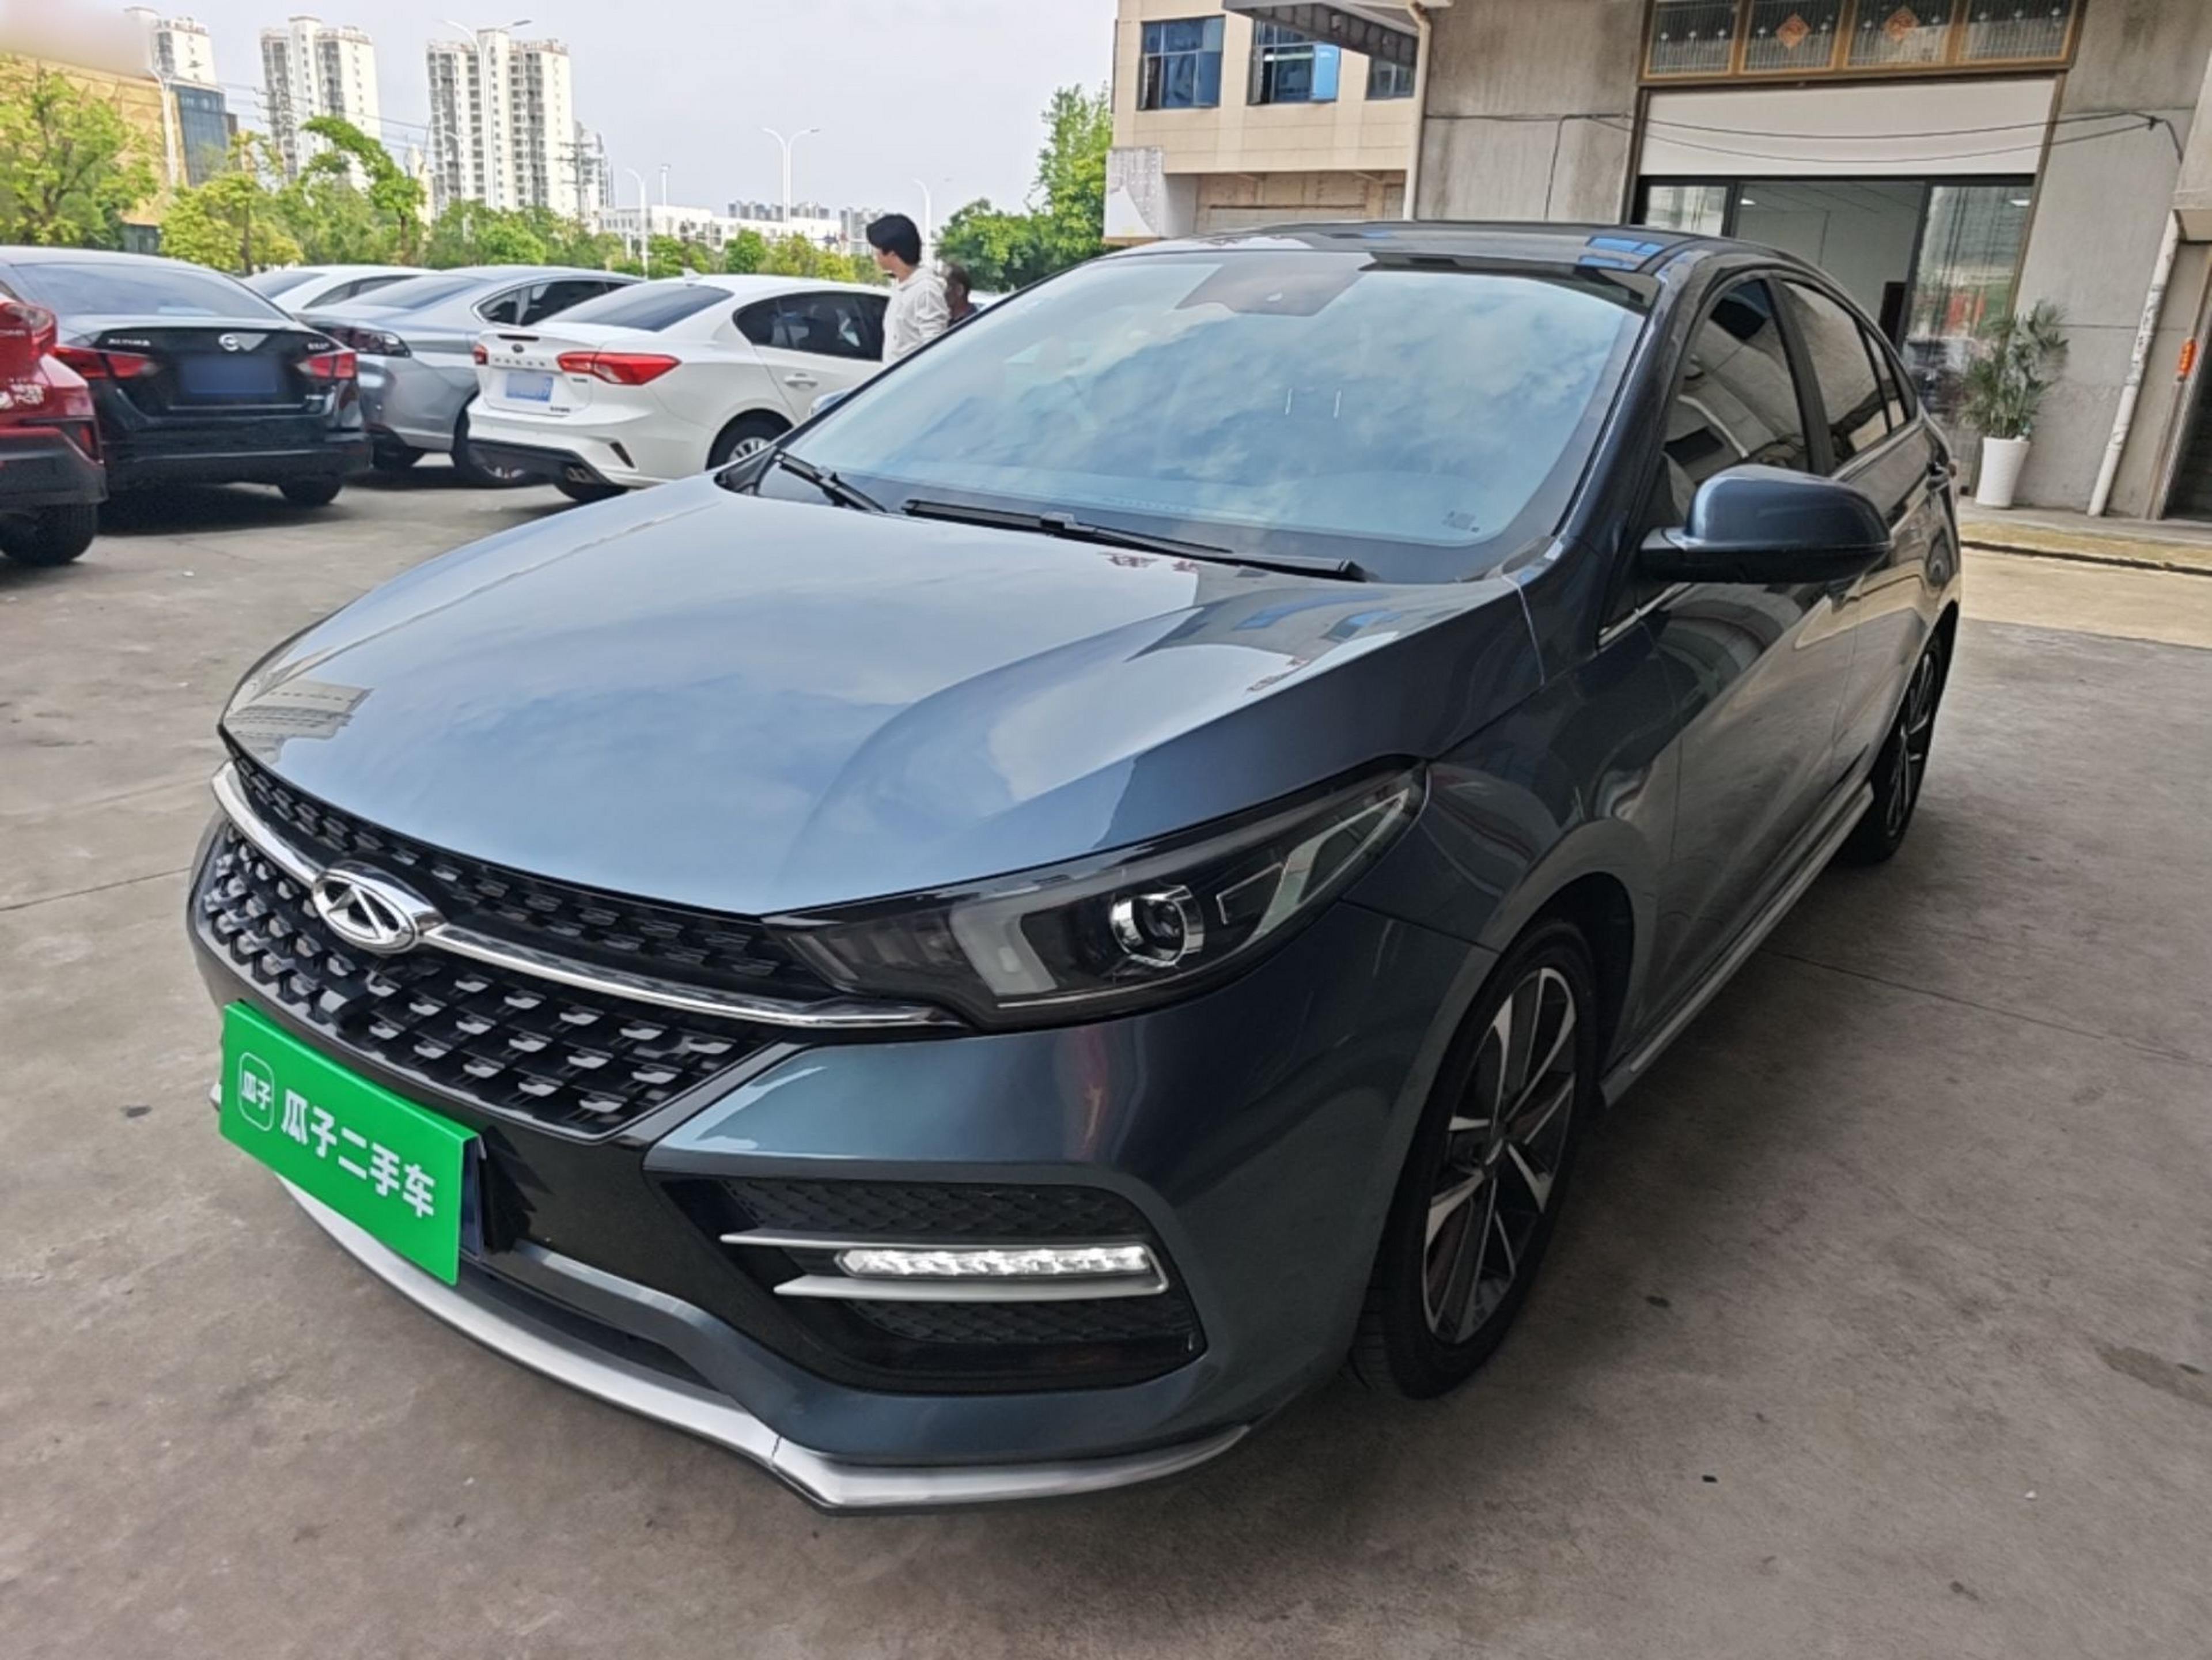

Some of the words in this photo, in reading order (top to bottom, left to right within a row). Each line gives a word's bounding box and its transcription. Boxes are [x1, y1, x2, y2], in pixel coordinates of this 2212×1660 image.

[242, 1071, 271, 1110] 瓜子
[281, 1088, 435, 1218] 瓜子二手车
